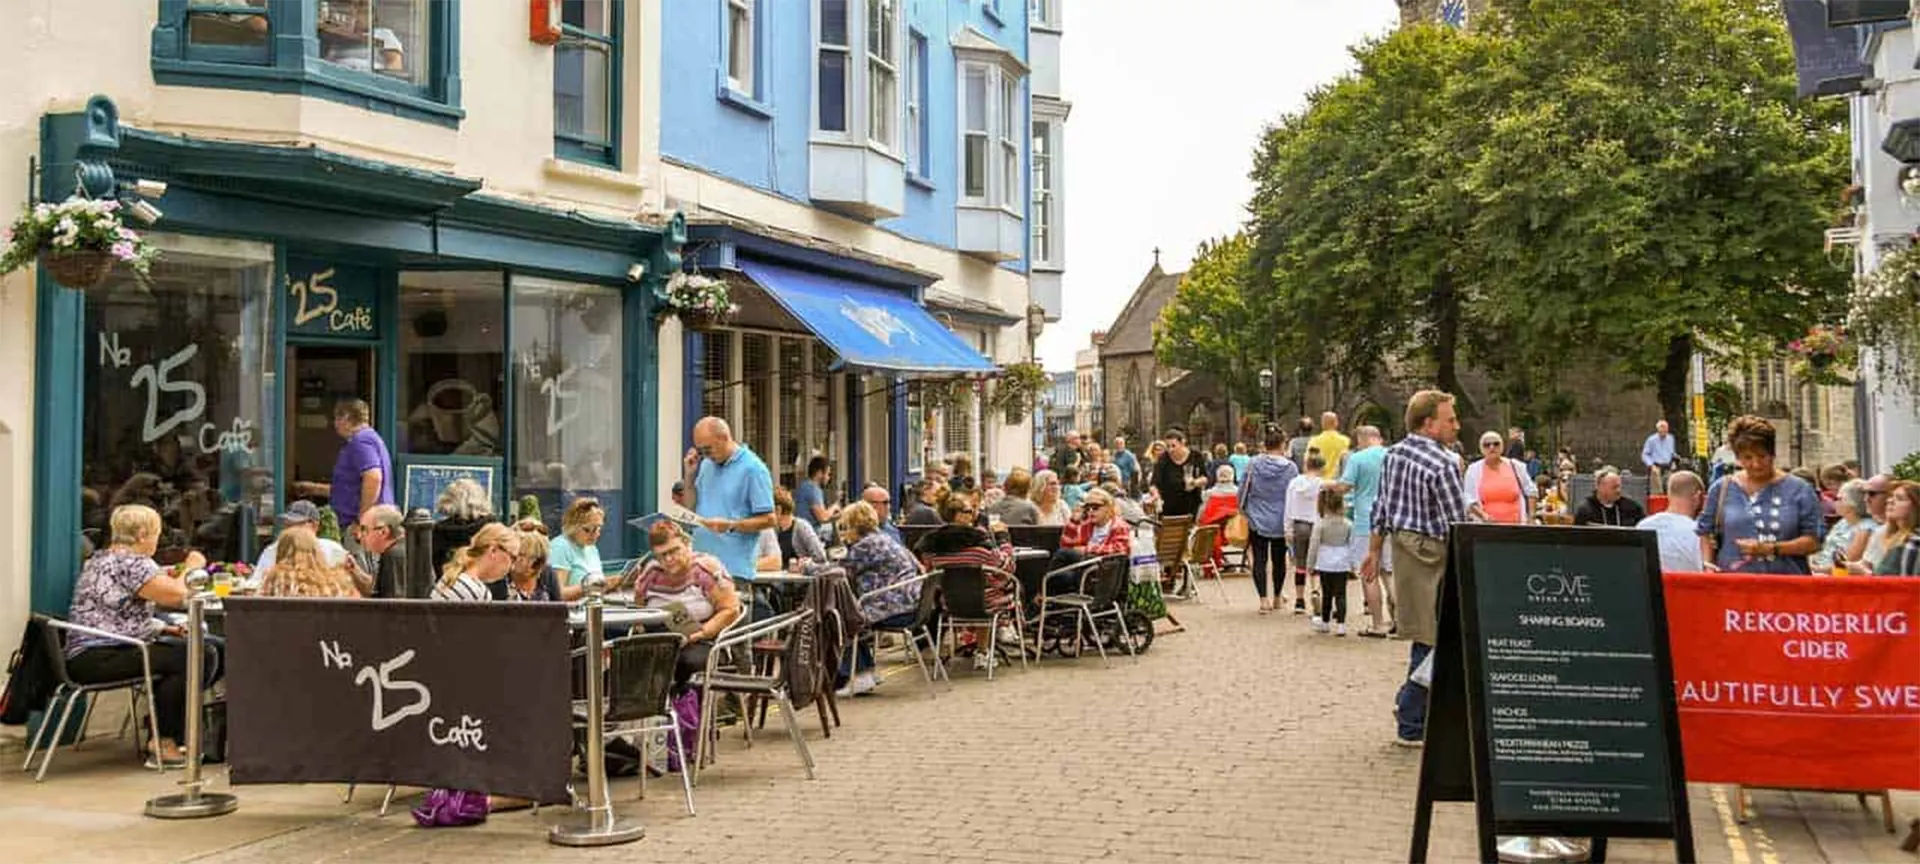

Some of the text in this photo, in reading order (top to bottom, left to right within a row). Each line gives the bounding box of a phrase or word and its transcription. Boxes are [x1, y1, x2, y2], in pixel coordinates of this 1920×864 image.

[291, 268, 373, 331] 25 Café
[130, 343, 206, 442] 25
[1724, 608, 1909, 635] REKORDERLIG
[1782, 639, 1849, 659] CIDER
[355, 649, 431, 731] 25
[429, 715, 488, 751] Café
[1674, 680, 1920, 709] AUTIFULLY SWE
